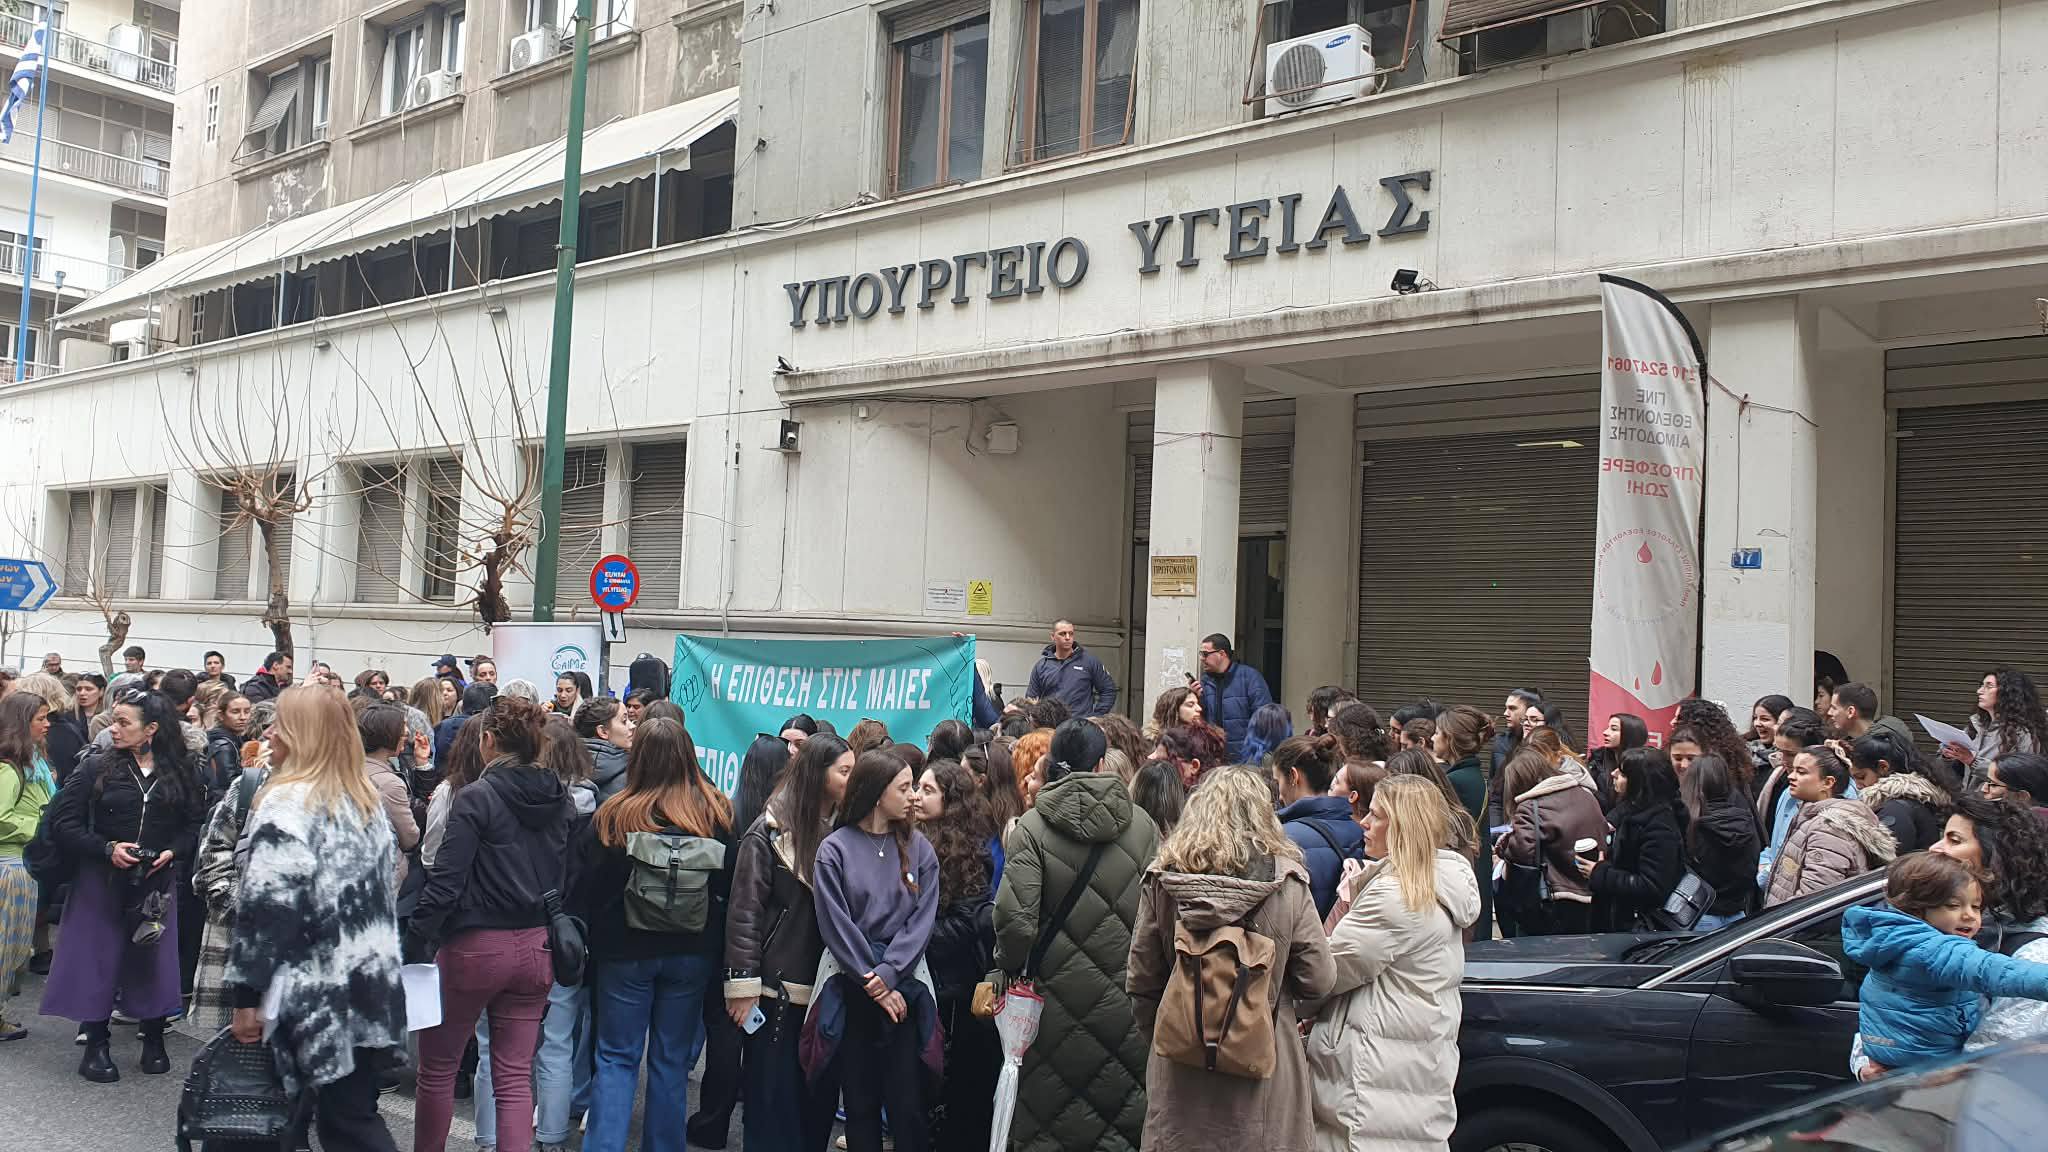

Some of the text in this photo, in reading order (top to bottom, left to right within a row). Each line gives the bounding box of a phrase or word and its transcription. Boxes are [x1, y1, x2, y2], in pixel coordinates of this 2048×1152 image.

[783, 171, 1431, 328] ΥΠΟΥΡΓΕΙΟ ΥΓΕΙΑΣ
[1739, 551, 1752, 565] 17
[711, 664, 932, 710] Η ΕΠΙΘΕΣΗ ΣΤΙΣ ΜΑΙΕΣ
